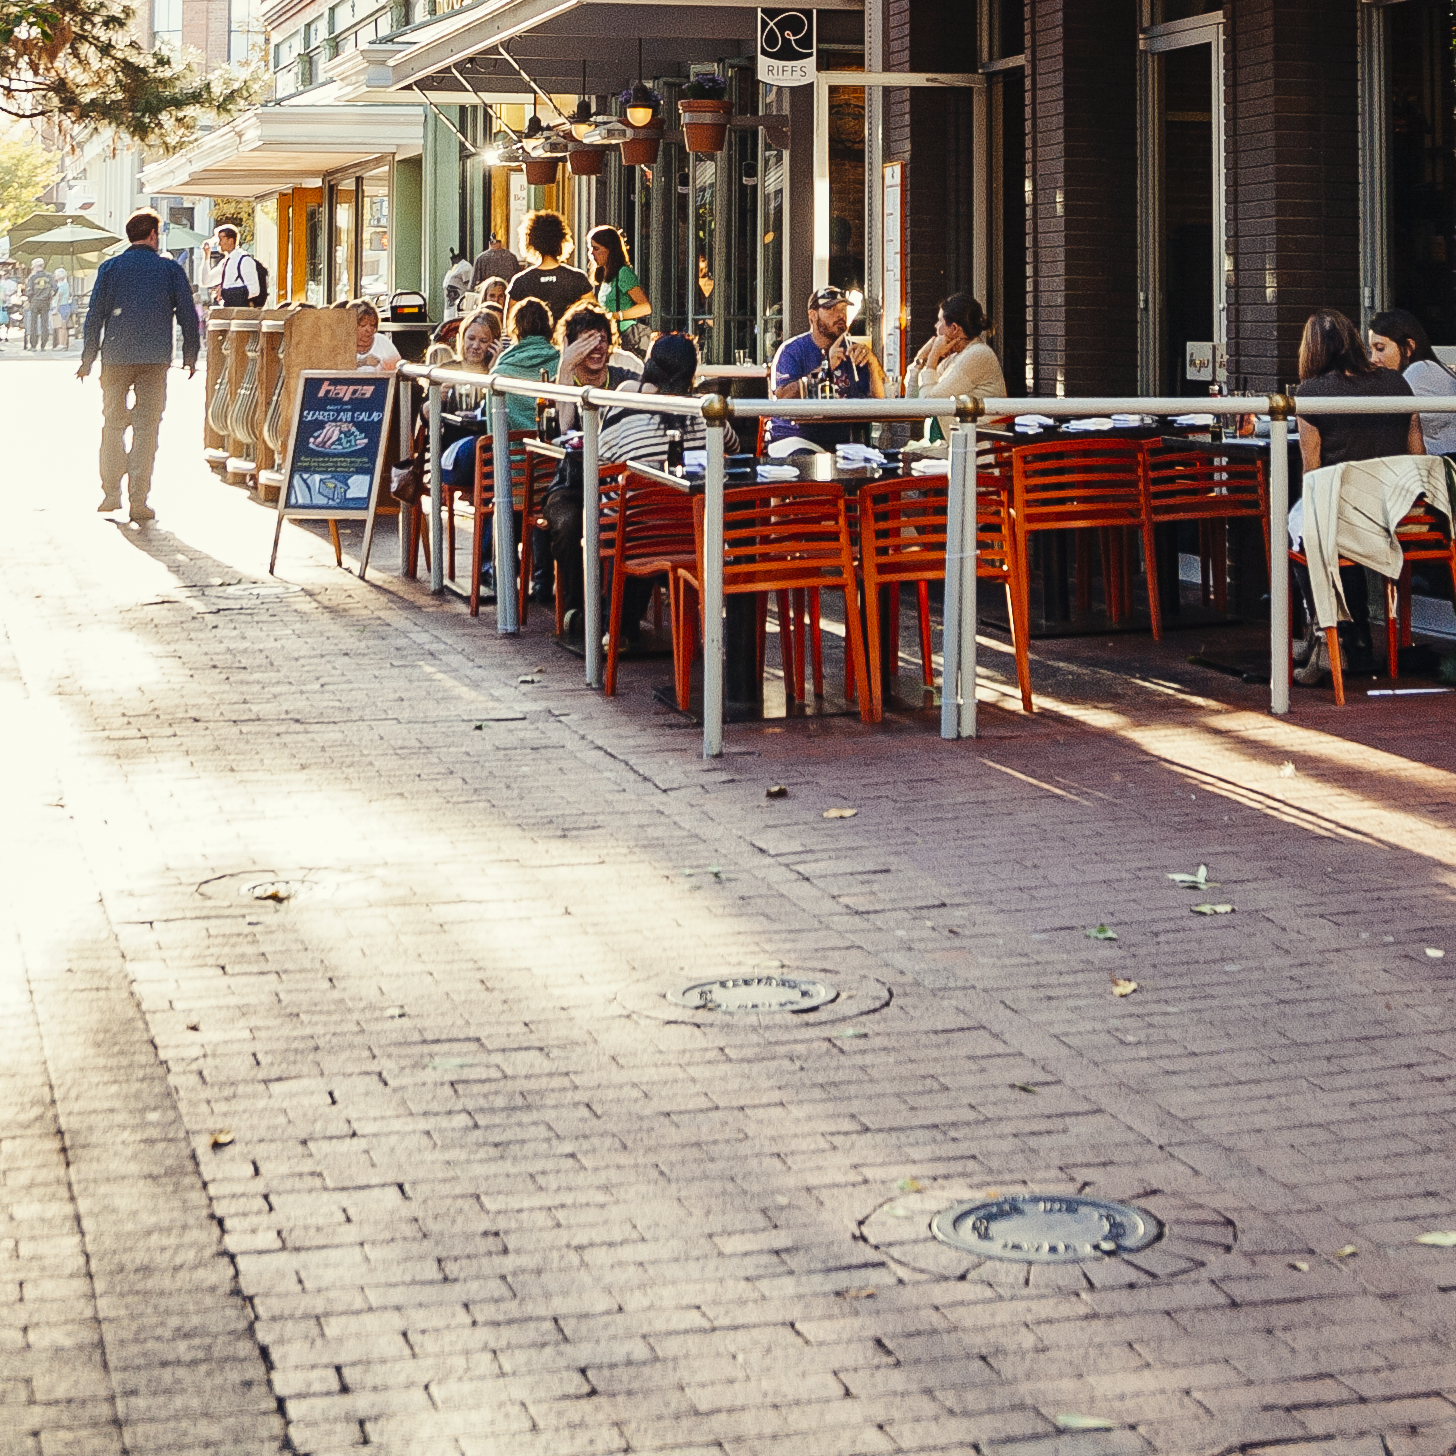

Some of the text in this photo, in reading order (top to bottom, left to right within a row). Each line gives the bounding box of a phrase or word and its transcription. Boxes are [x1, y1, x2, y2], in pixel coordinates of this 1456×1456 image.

[767, 65, 807, 78] RIFFS
[318, 380, 375, 401] hapa
[354, 411, 382, 422] SALAD
